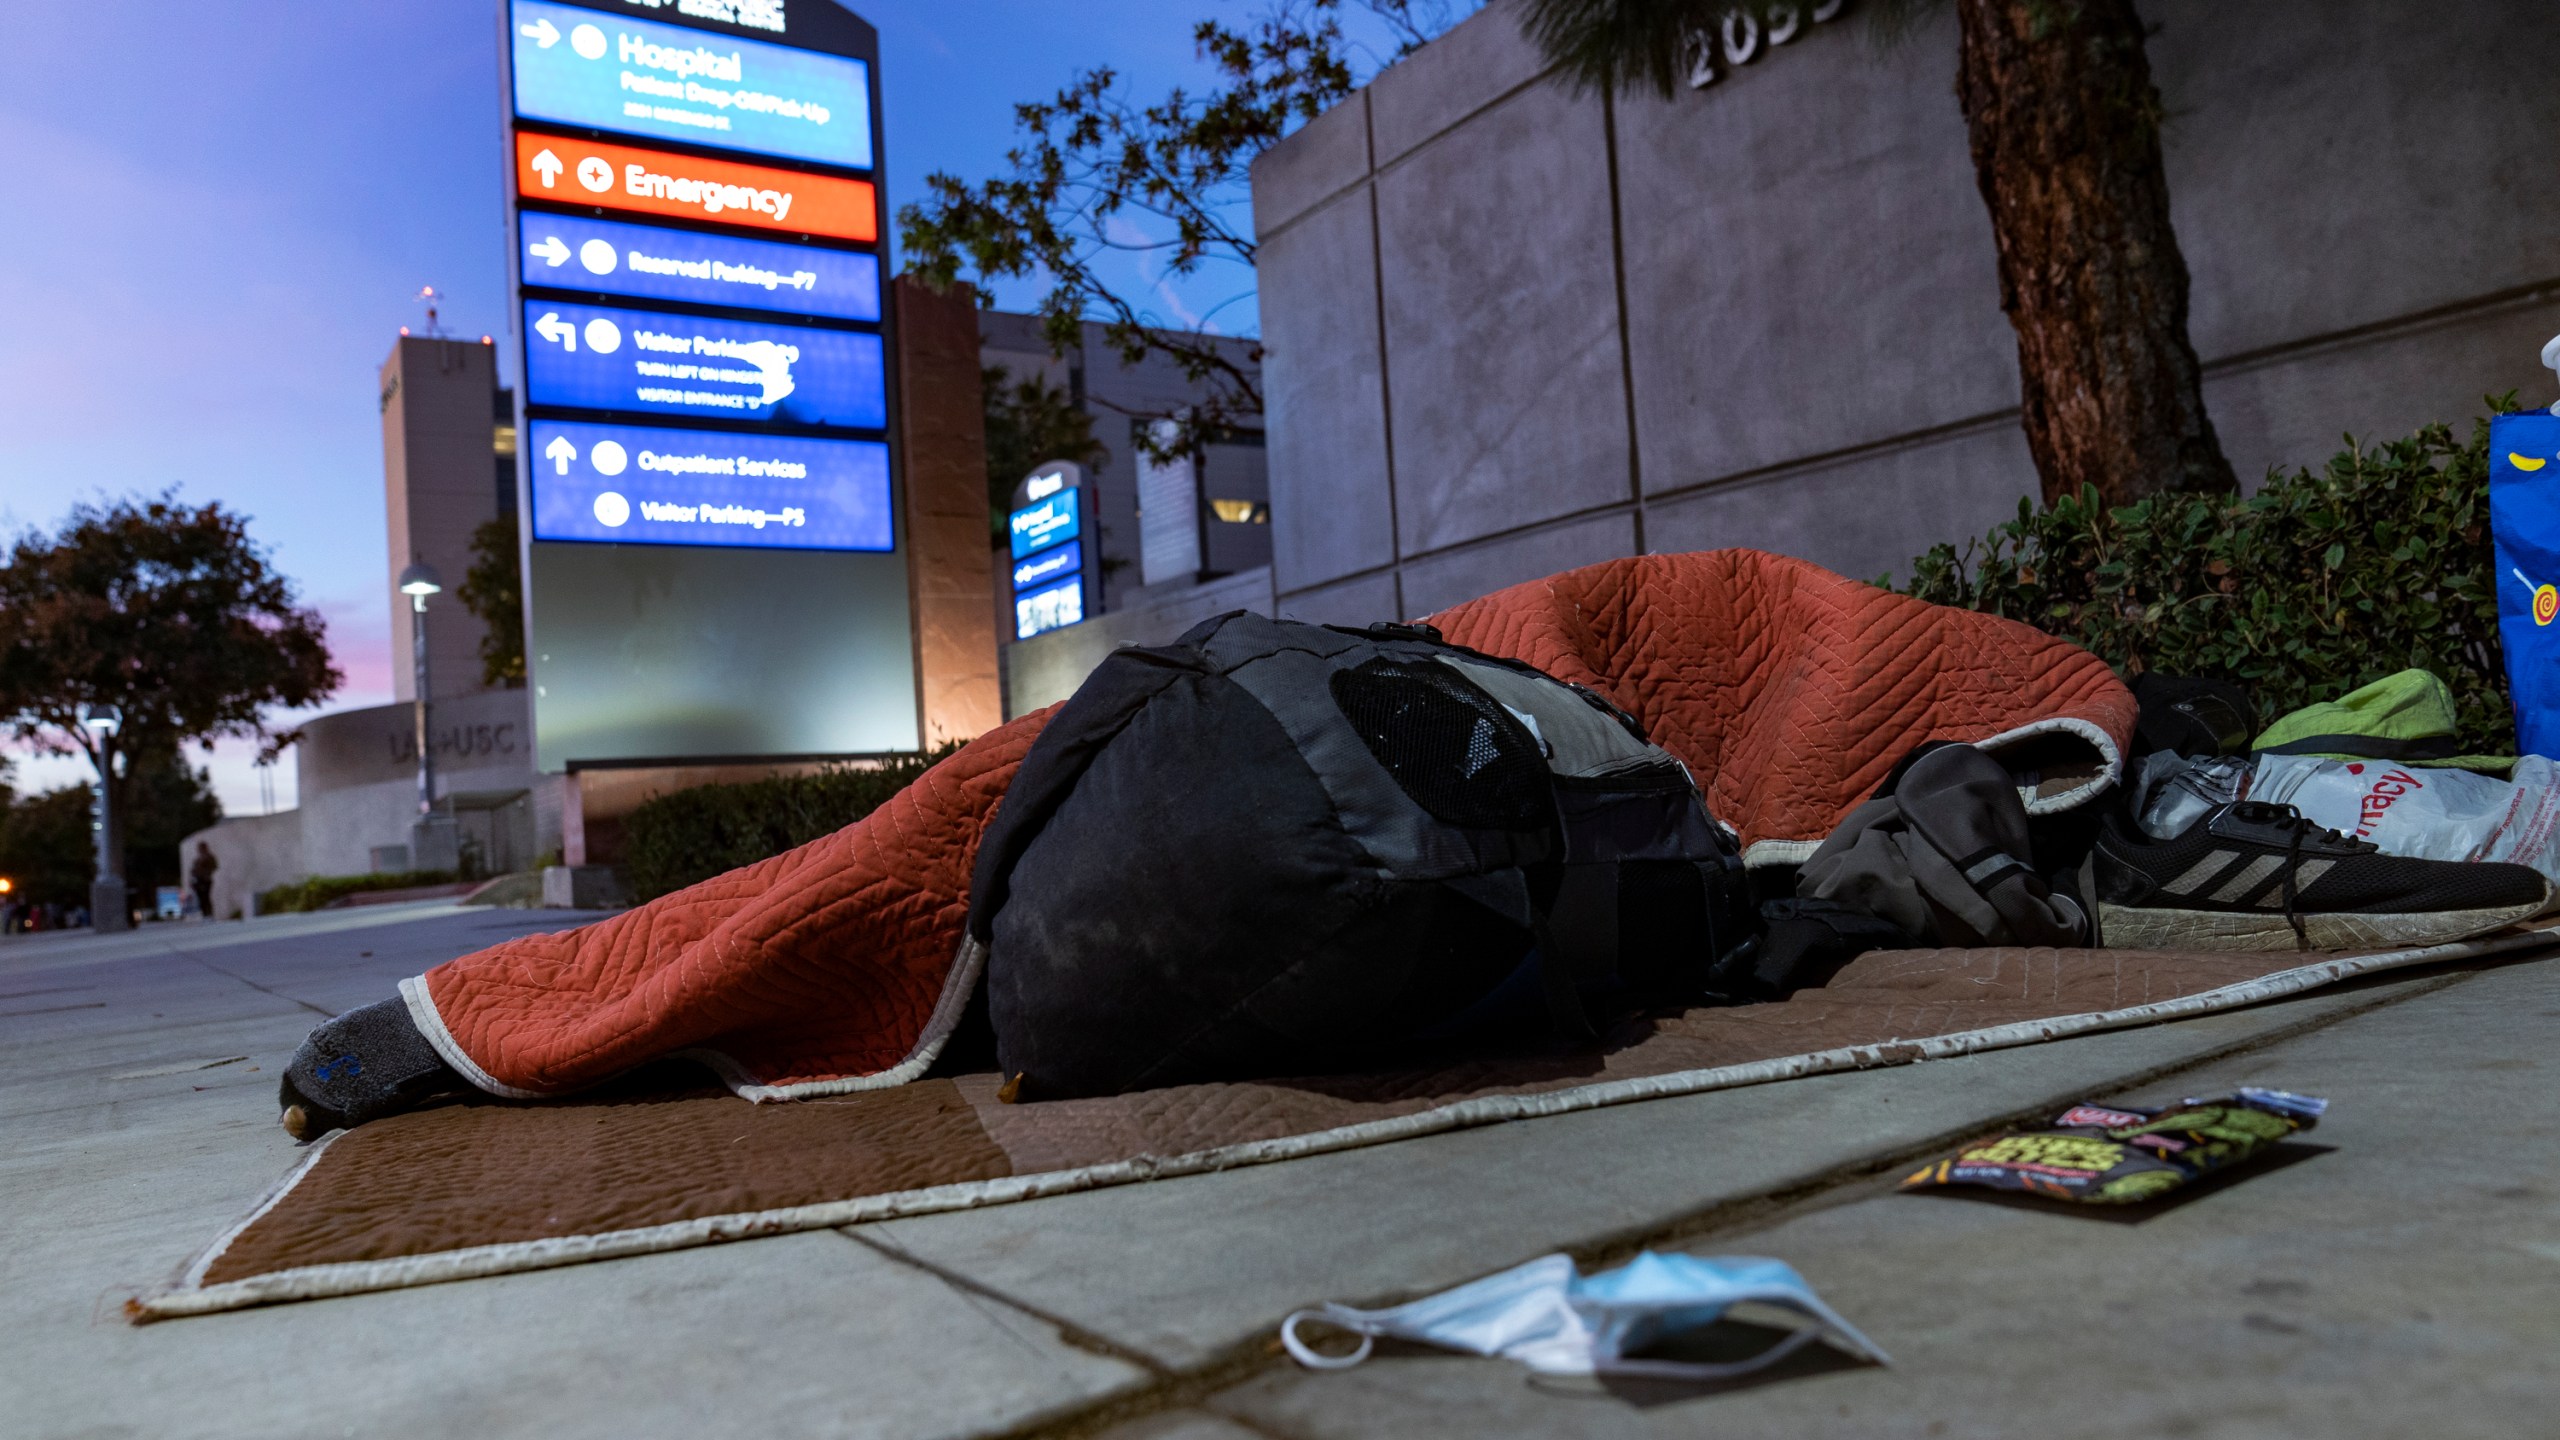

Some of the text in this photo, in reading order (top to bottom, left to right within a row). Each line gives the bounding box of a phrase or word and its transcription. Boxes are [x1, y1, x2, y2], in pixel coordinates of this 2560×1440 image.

[618, 33, 741, 82] Hospital
[625, 164, 792, 221] Emergency
[629, 251, 711, 280] Reserved
[633, 330, 692, 354] Visitor
[638, 451, 806, 479] Outpatient Services
[640, 502, 698, 523] Visitor
